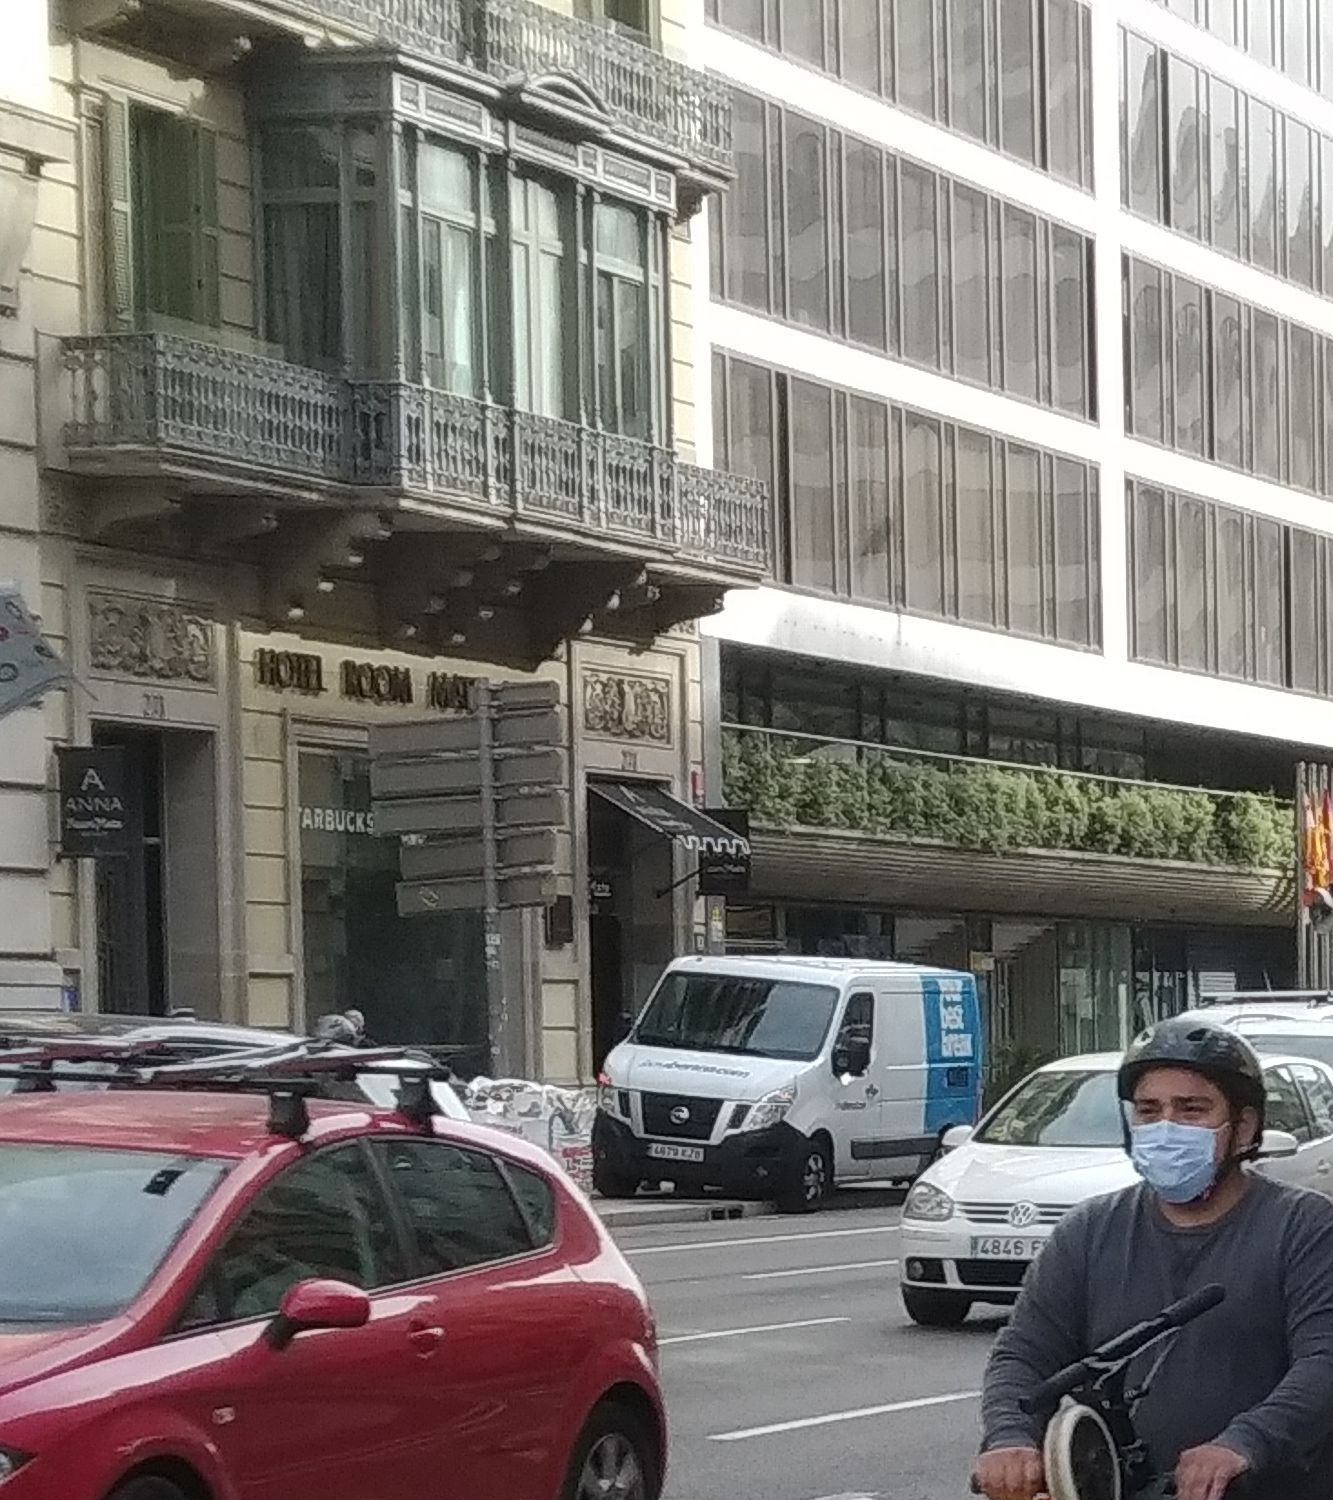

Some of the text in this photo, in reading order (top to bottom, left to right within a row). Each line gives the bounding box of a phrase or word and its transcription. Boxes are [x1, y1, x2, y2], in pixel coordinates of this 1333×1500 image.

[255, 648, 327, 694] HOTEL
[340, 659, 414, 704] ROOM
[65, 797, 123, 812] ANNA
[299, 807, 374, 833] ARBUCKS
[980, 1239, 1049, 1257] 4846 F
